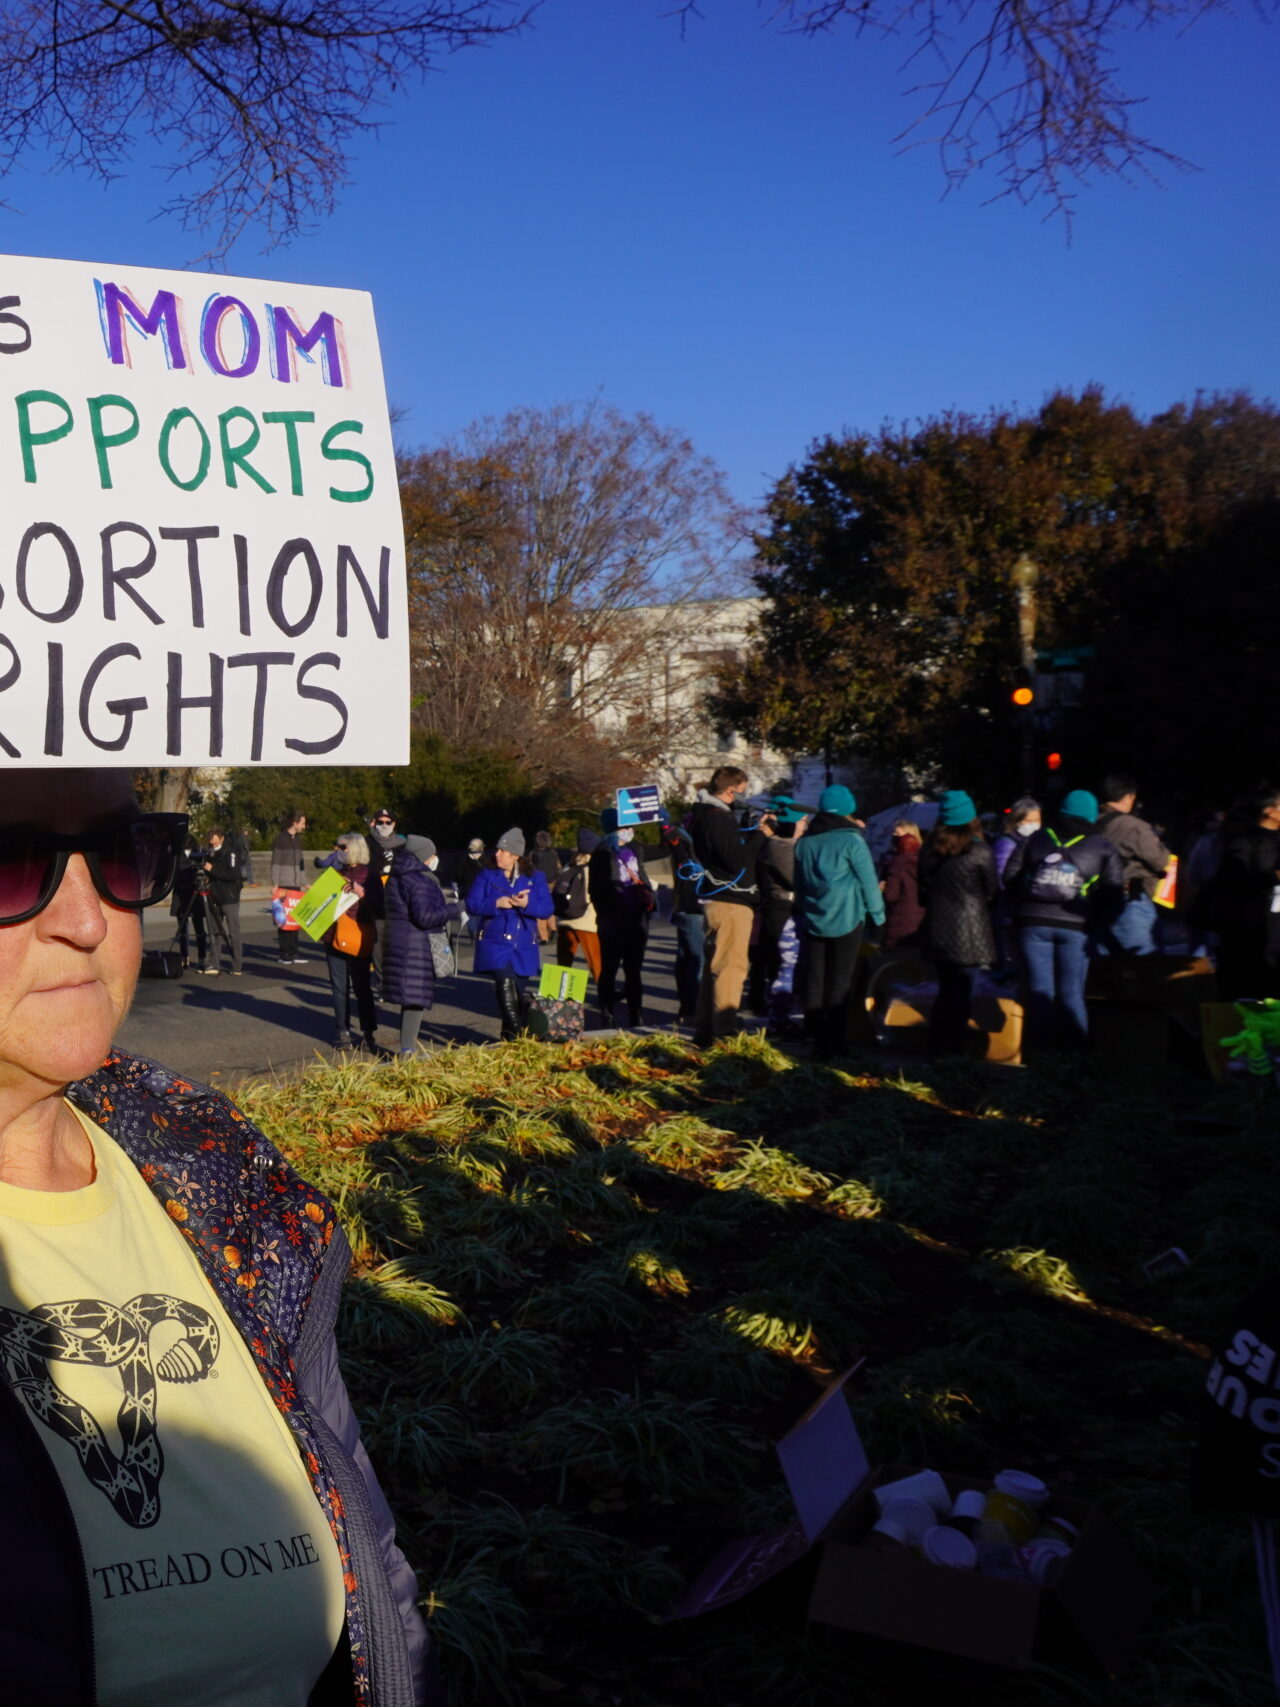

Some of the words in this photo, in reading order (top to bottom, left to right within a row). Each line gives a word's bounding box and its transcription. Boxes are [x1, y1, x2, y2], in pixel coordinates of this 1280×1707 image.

[93, 277, 353, 391] MOM
[92, 1552, 212, 1600] TREAD
[220, 1542, 274, 1578] ON
[274, 1533, 320, 1570] ME
